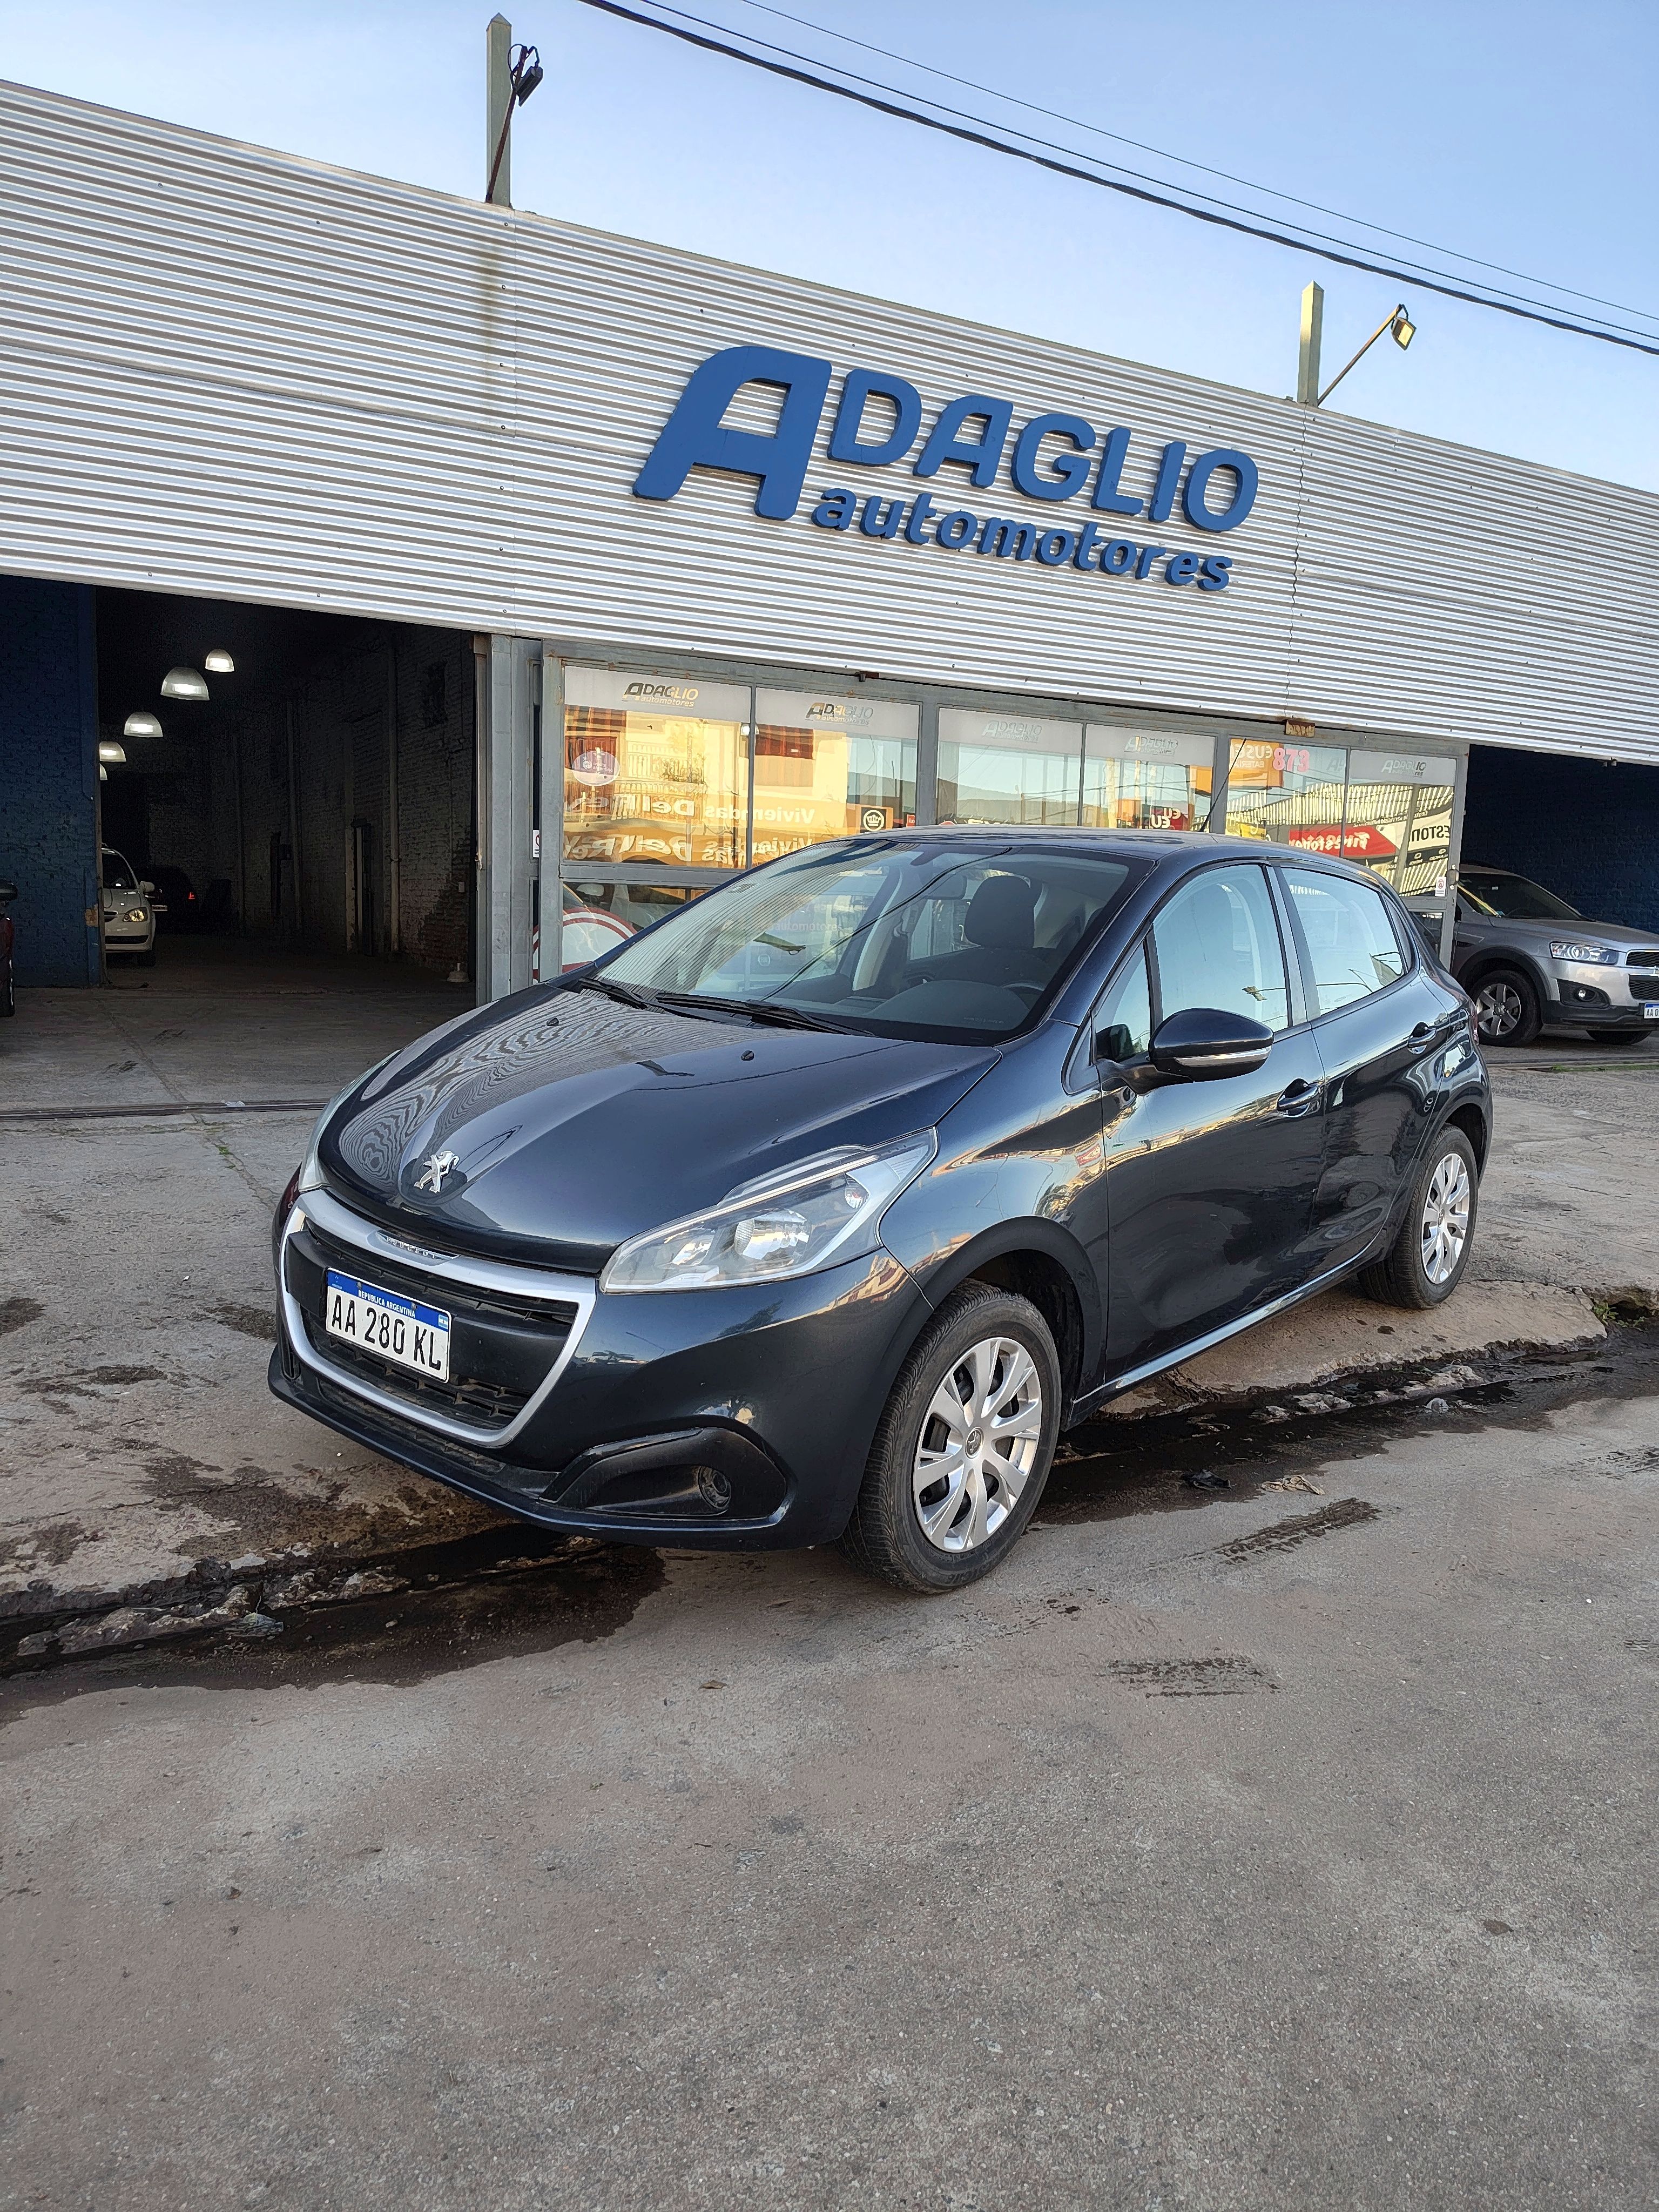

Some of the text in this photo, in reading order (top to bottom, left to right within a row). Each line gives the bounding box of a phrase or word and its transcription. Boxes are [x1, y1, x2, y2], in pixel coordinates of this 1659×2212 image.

[631, 346, 1260, 534] ADAGLIO
[812, 488, 1233, 593] automotores
[622, 682, 699, 702] ADAGLIO
[640, 696, 694, 707] automotores
[805, 702, 873, 720] ADAGLIO
[1272, 747, 1310, 772] 873
[387, 1237, 435, 1259] PEUGEOT
[358, 1289, 415, 1319] REPUBLICA ARGENTINA
[332, 1294, 441, 1371] AA 280 KL
